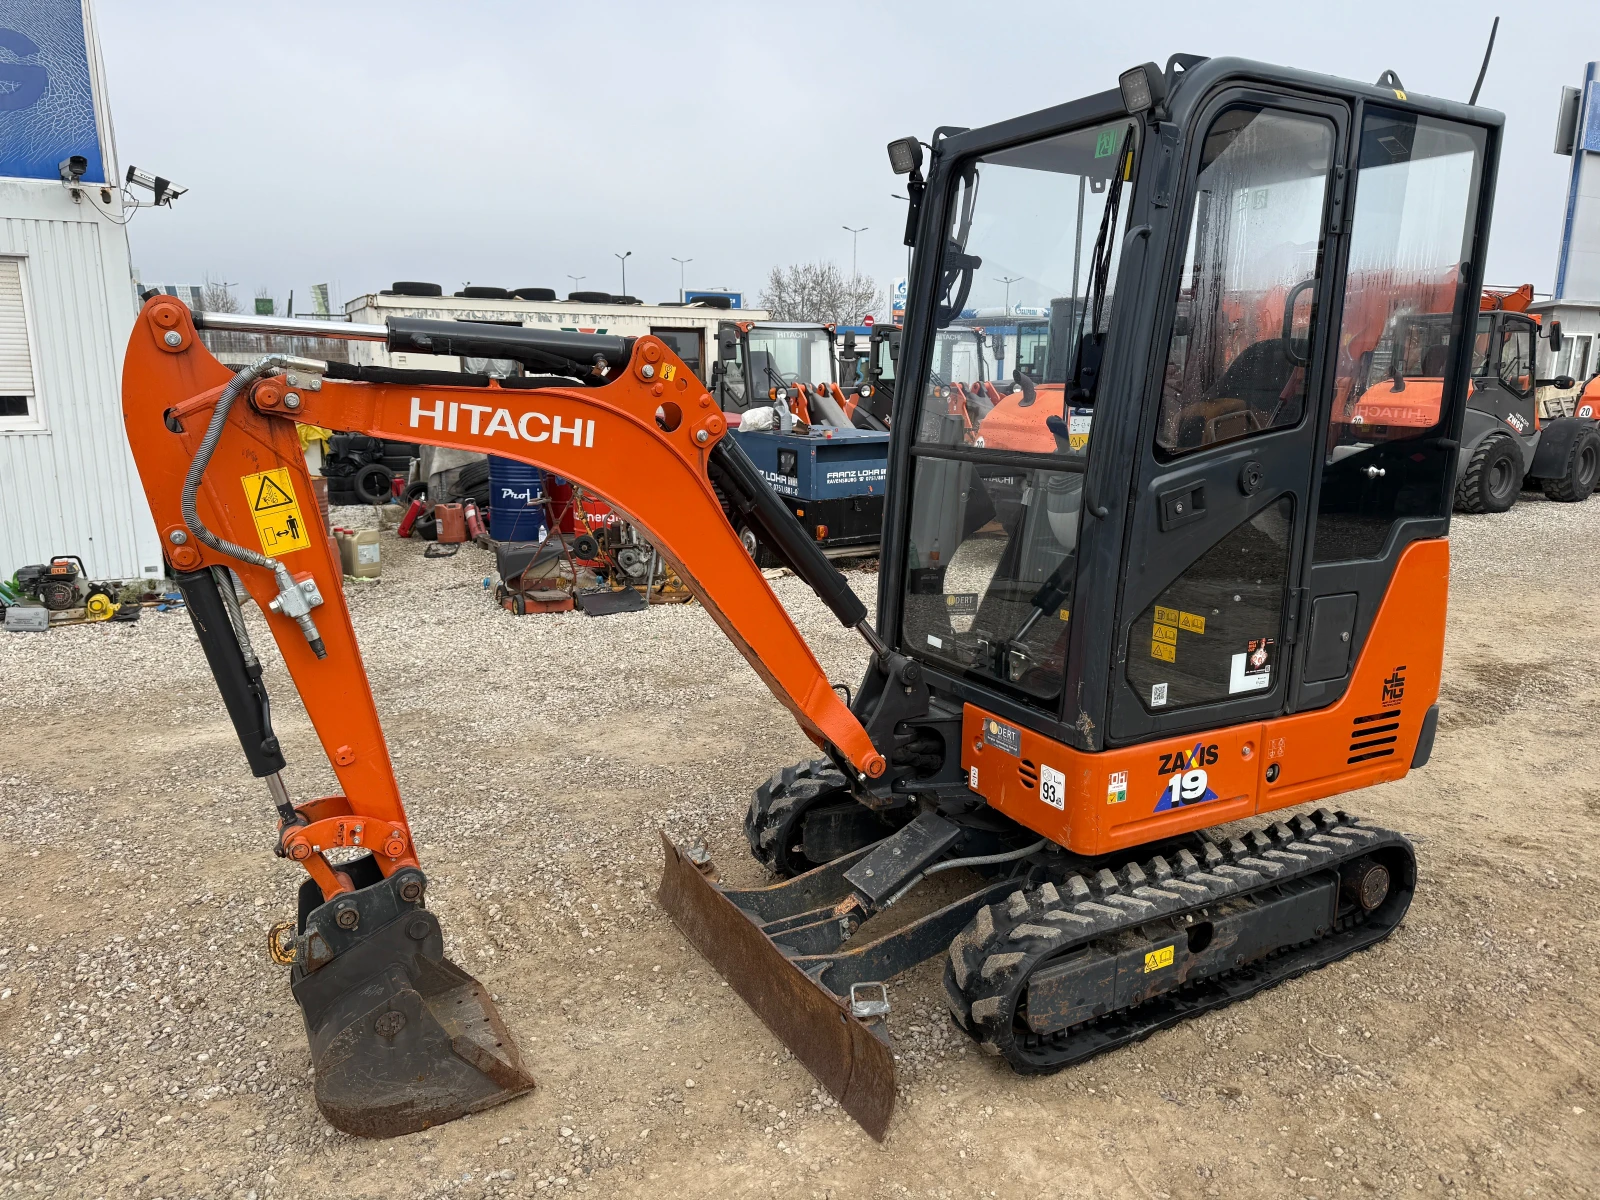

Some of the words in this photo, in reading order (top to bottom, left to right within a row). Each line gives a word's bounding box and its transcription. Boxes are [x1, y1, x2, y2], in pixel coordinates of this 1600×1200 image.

[777, 331, 808, 339] HITACHI
[1580, 407, 1591, 417] 20
[408, 396, 596, 449] HITACHI
[765, 471, 787, 485] LOHR
[826, 470, 857, 479] FRANZ
[857, 468, 880, 477] LOHR
[1157, 742, 1219, 776] ZAXIS
[1042, 781, 1056, 803] 93
[1167, 768, 1209, 804] 19
